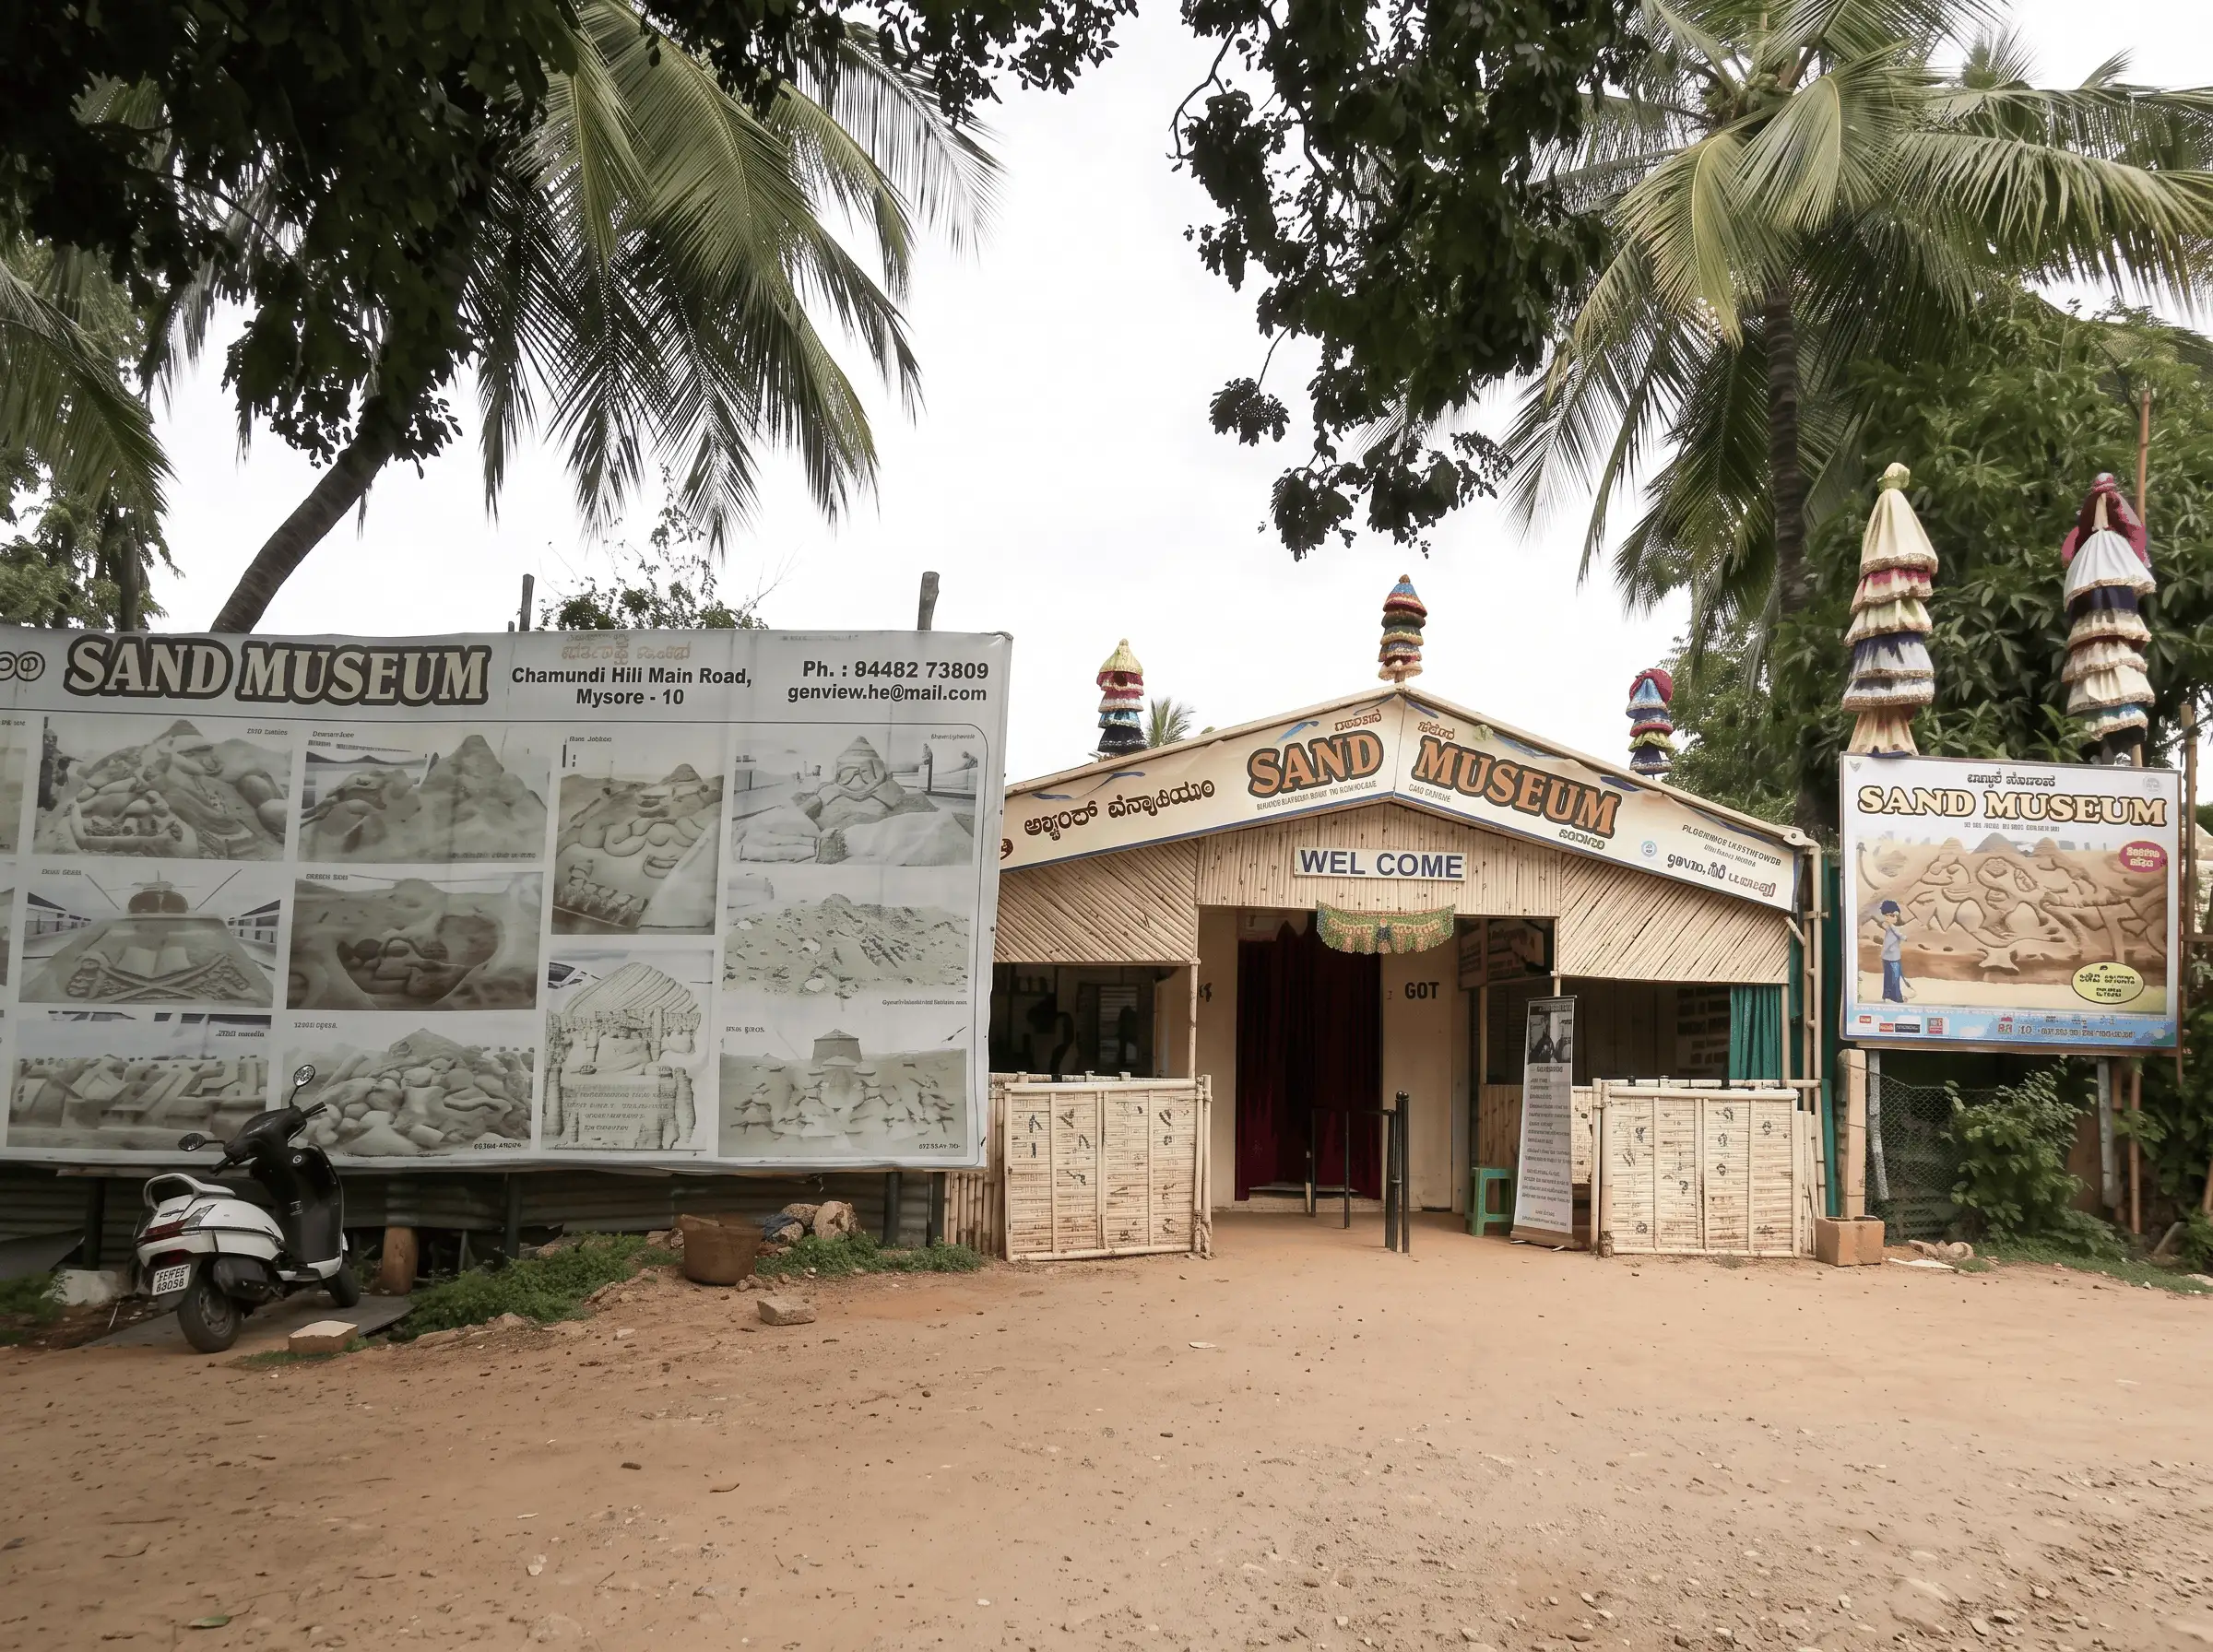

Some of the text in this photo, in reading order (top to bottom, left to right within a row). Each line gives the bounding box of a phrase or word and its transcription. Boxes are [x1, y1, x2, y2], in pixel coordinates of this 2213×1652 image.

[64, 634, 233, 699] SAND
[235, 640, 491, 706] MUSEUM
[512, 667, 605, 683] Chamundi
[648, 667, 692, 683] Main
[699, 668, 751, 688] Road,
[803, 661, 834, 677] Ph.
[926, 662, 988, 678] 73809
[576, 689, 644, 708] Mysore
[663, 690, 684, 704] 10
[1247, 730, 1622, 839] SAND MUSEUM
[1857, 785, 2169, 827] SAND MUSEUM
[1300, 850, 1462, 878] WEL COME
[1405, 982, 1439, 999] GOT
